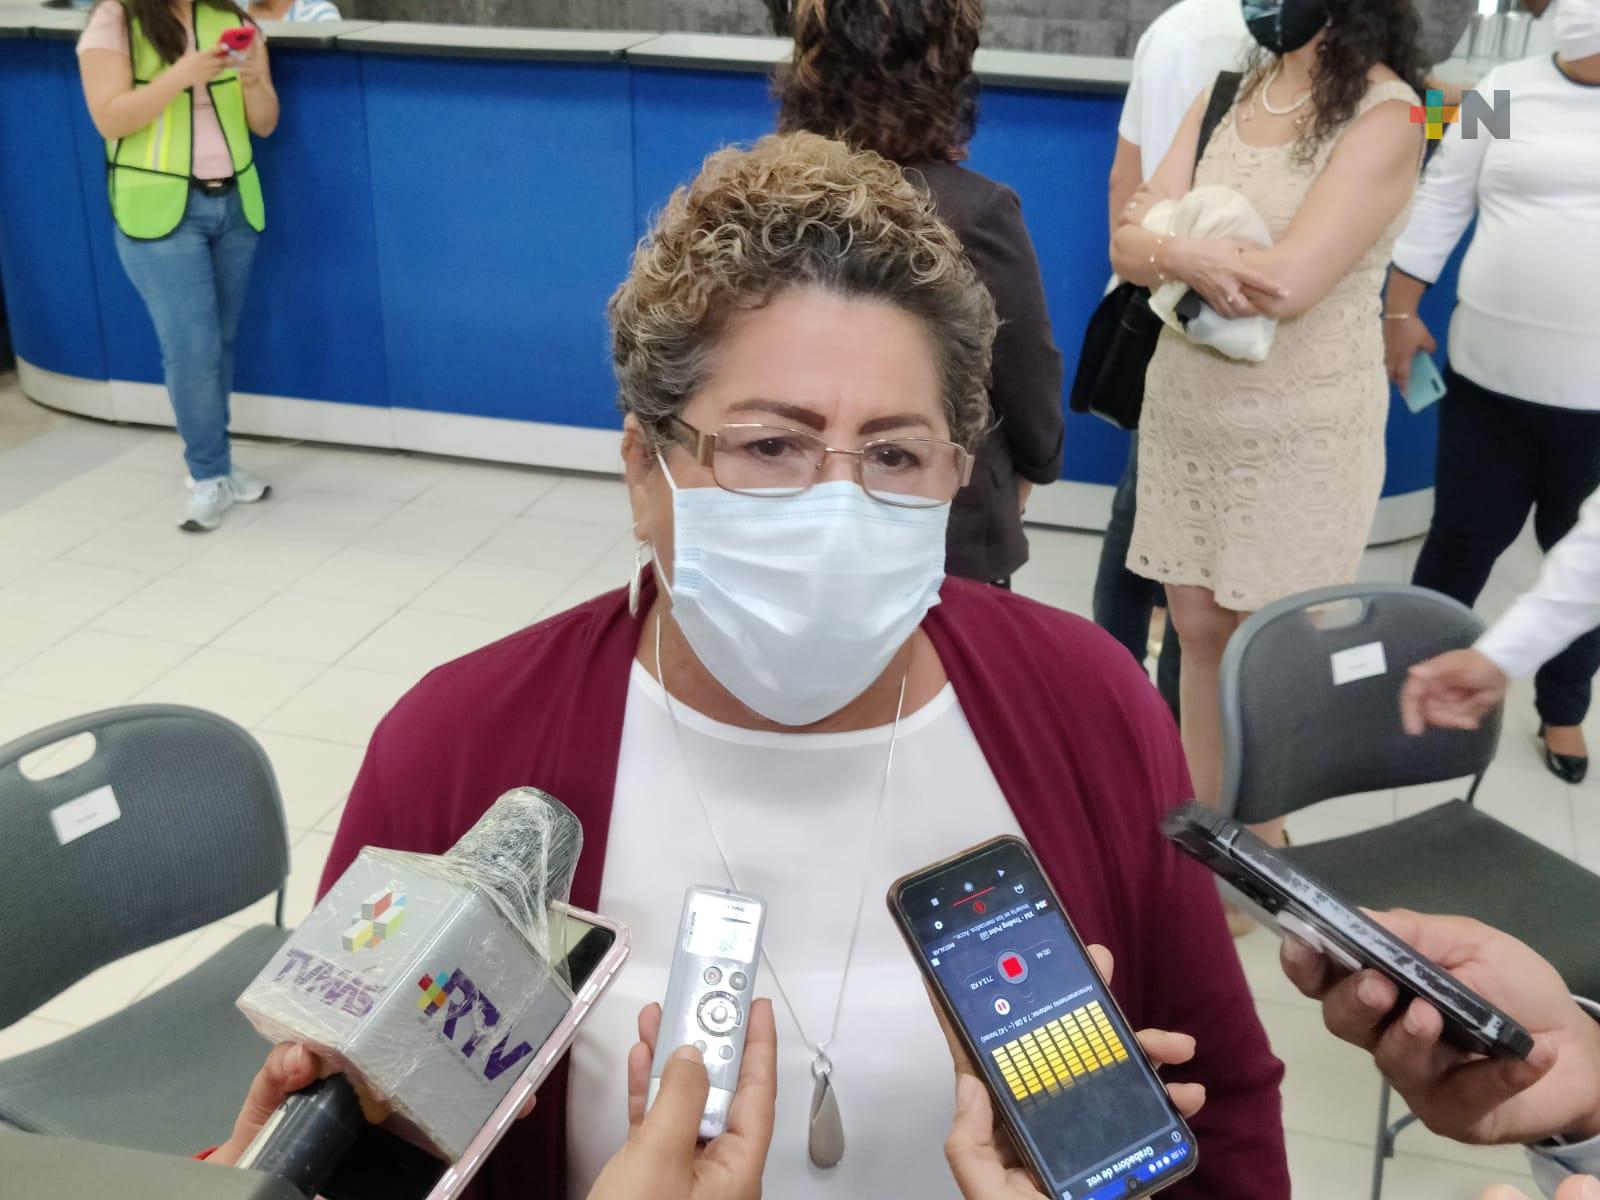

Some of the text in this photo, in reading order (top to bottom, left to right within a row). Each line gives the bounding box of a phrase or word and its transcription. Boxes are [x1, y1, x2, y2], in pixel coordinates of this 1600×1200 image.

[1001, 917, 1022, 929] Trading
[1086, 1146, 1154, 1187] Grabadora de voz
